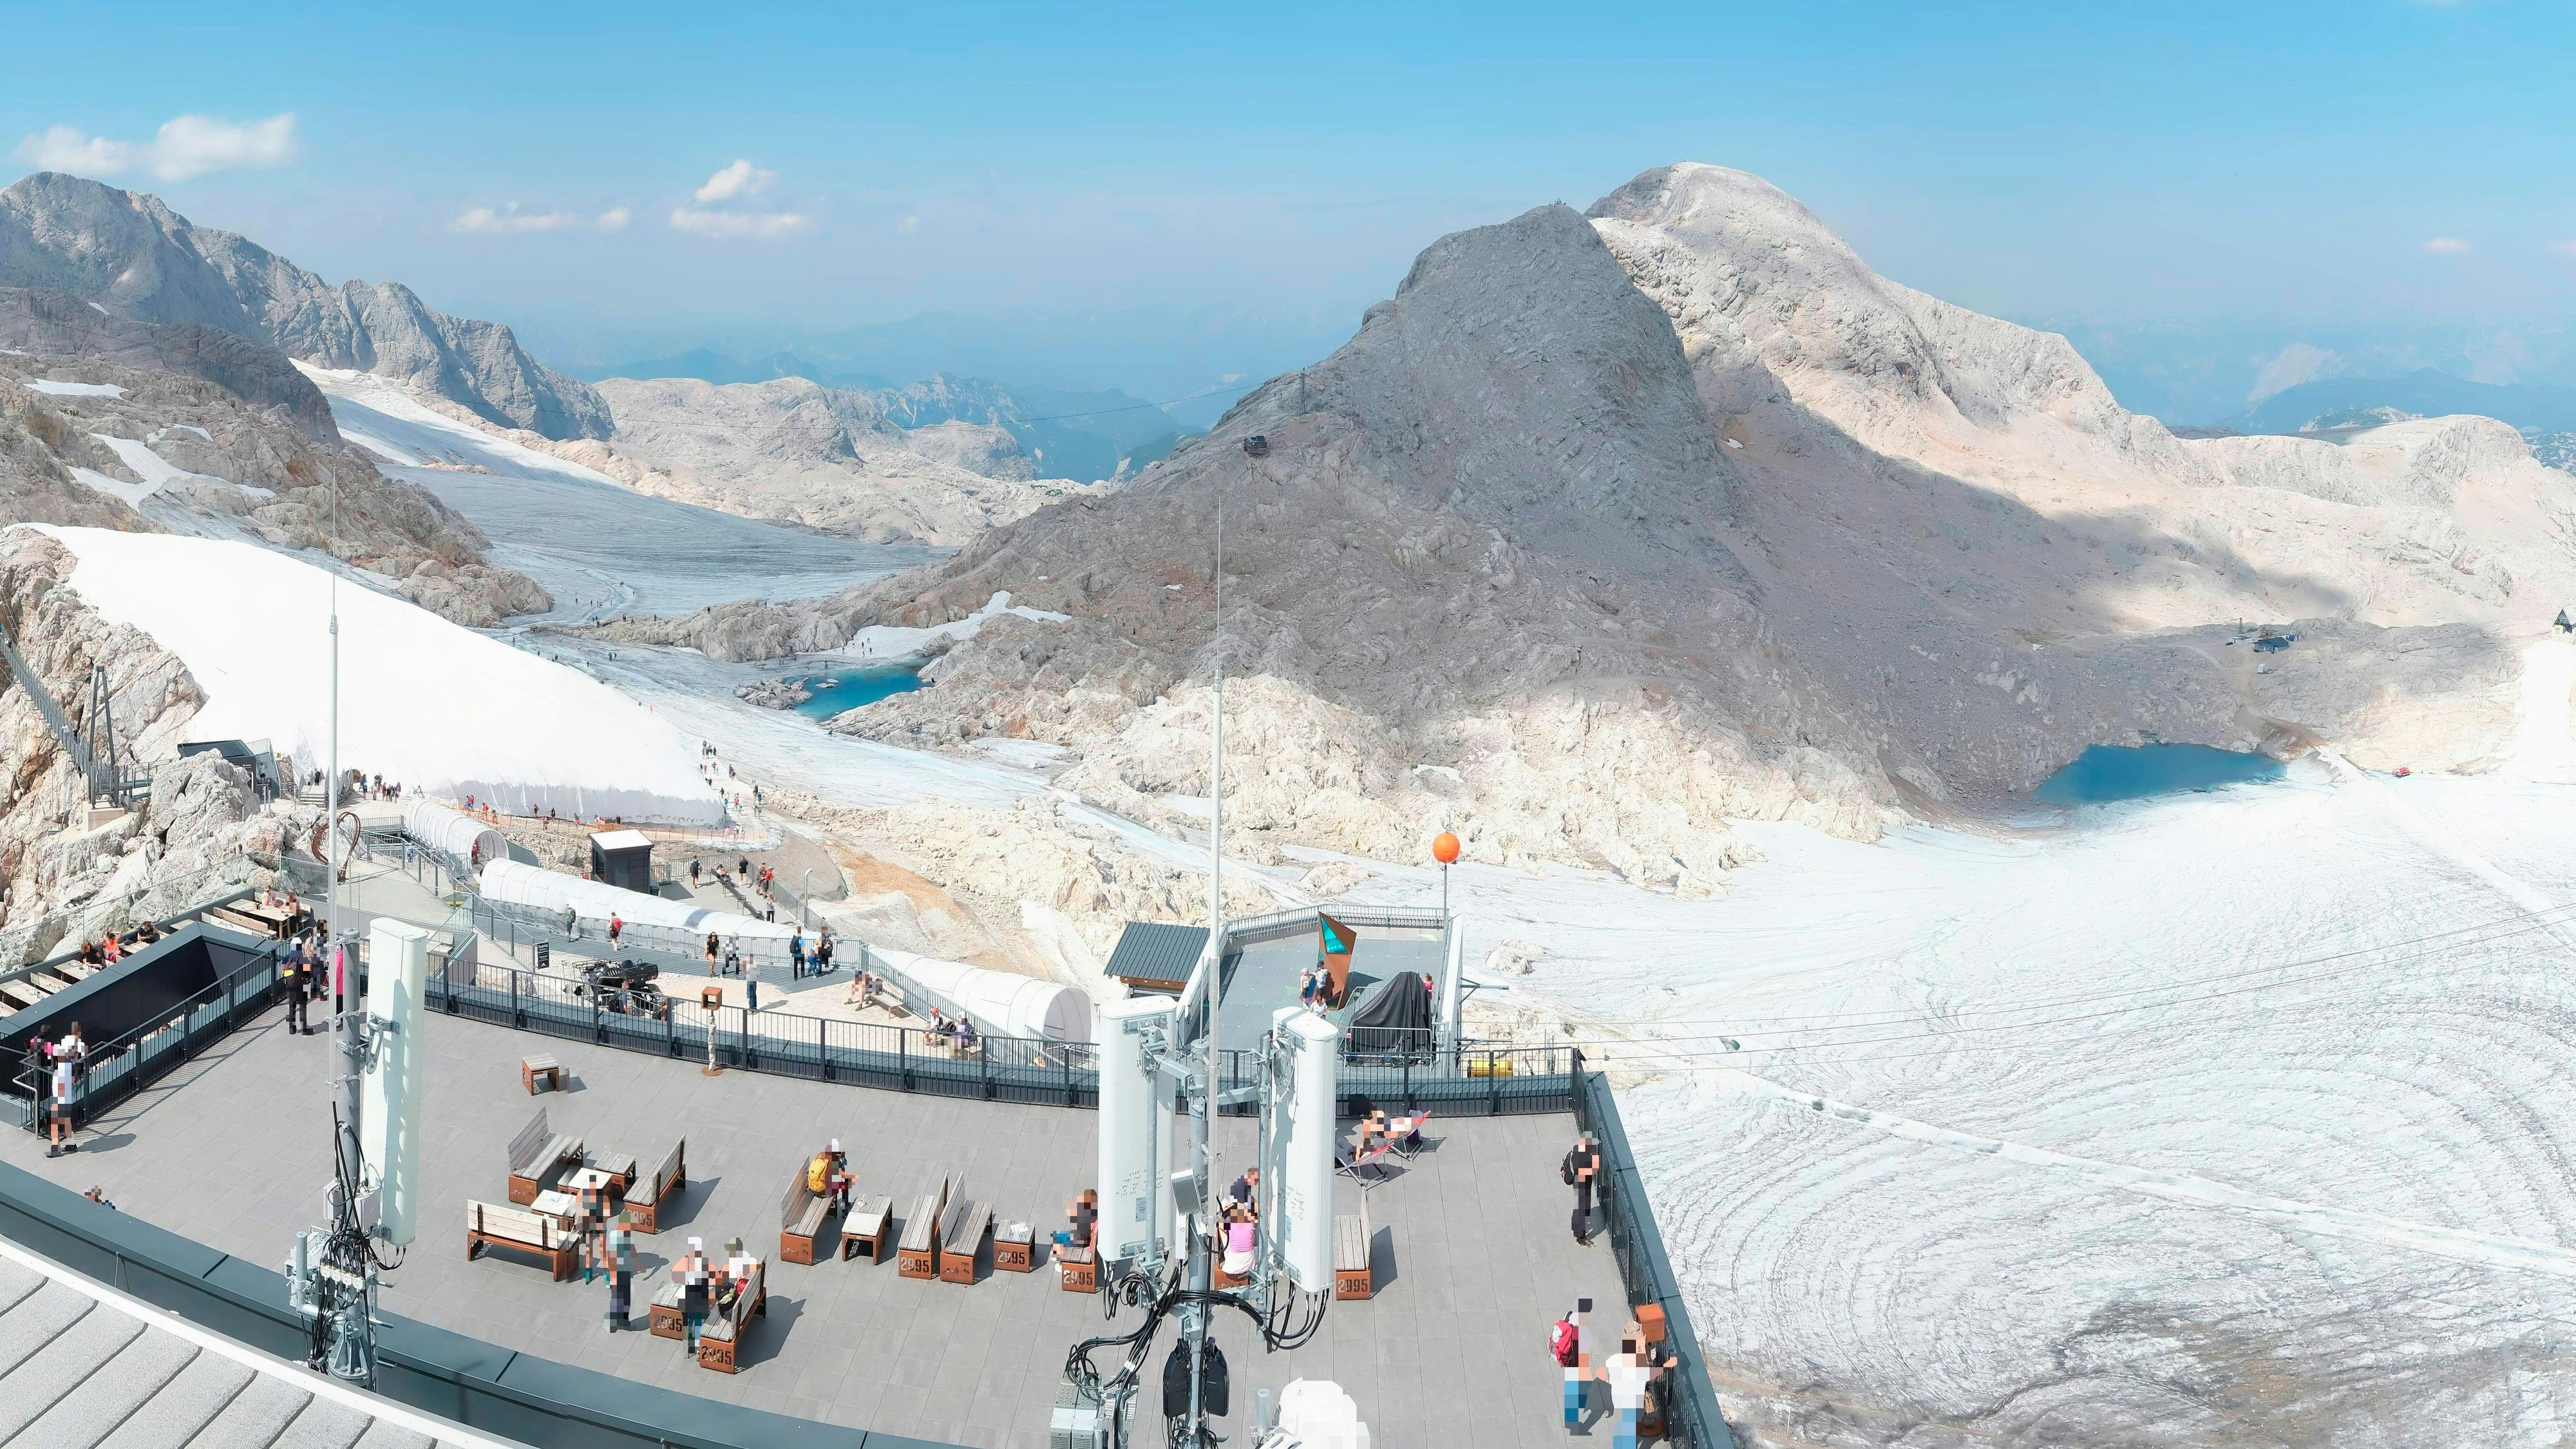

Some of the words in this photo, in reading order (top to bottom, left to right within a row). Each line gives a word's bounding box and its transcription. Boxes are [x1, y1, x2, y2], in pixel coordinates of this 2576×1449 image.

[627, 1210, 652, 1227] 995
[900, 1256, 929, 1273] 2995
[998, 1250, 1025, 1265] 2995
[1063, 1269, 1093, 1285] 2995
[1338, 1278, 1368, 1293] 2995
[701, 1346, 732, 1365] 2995
